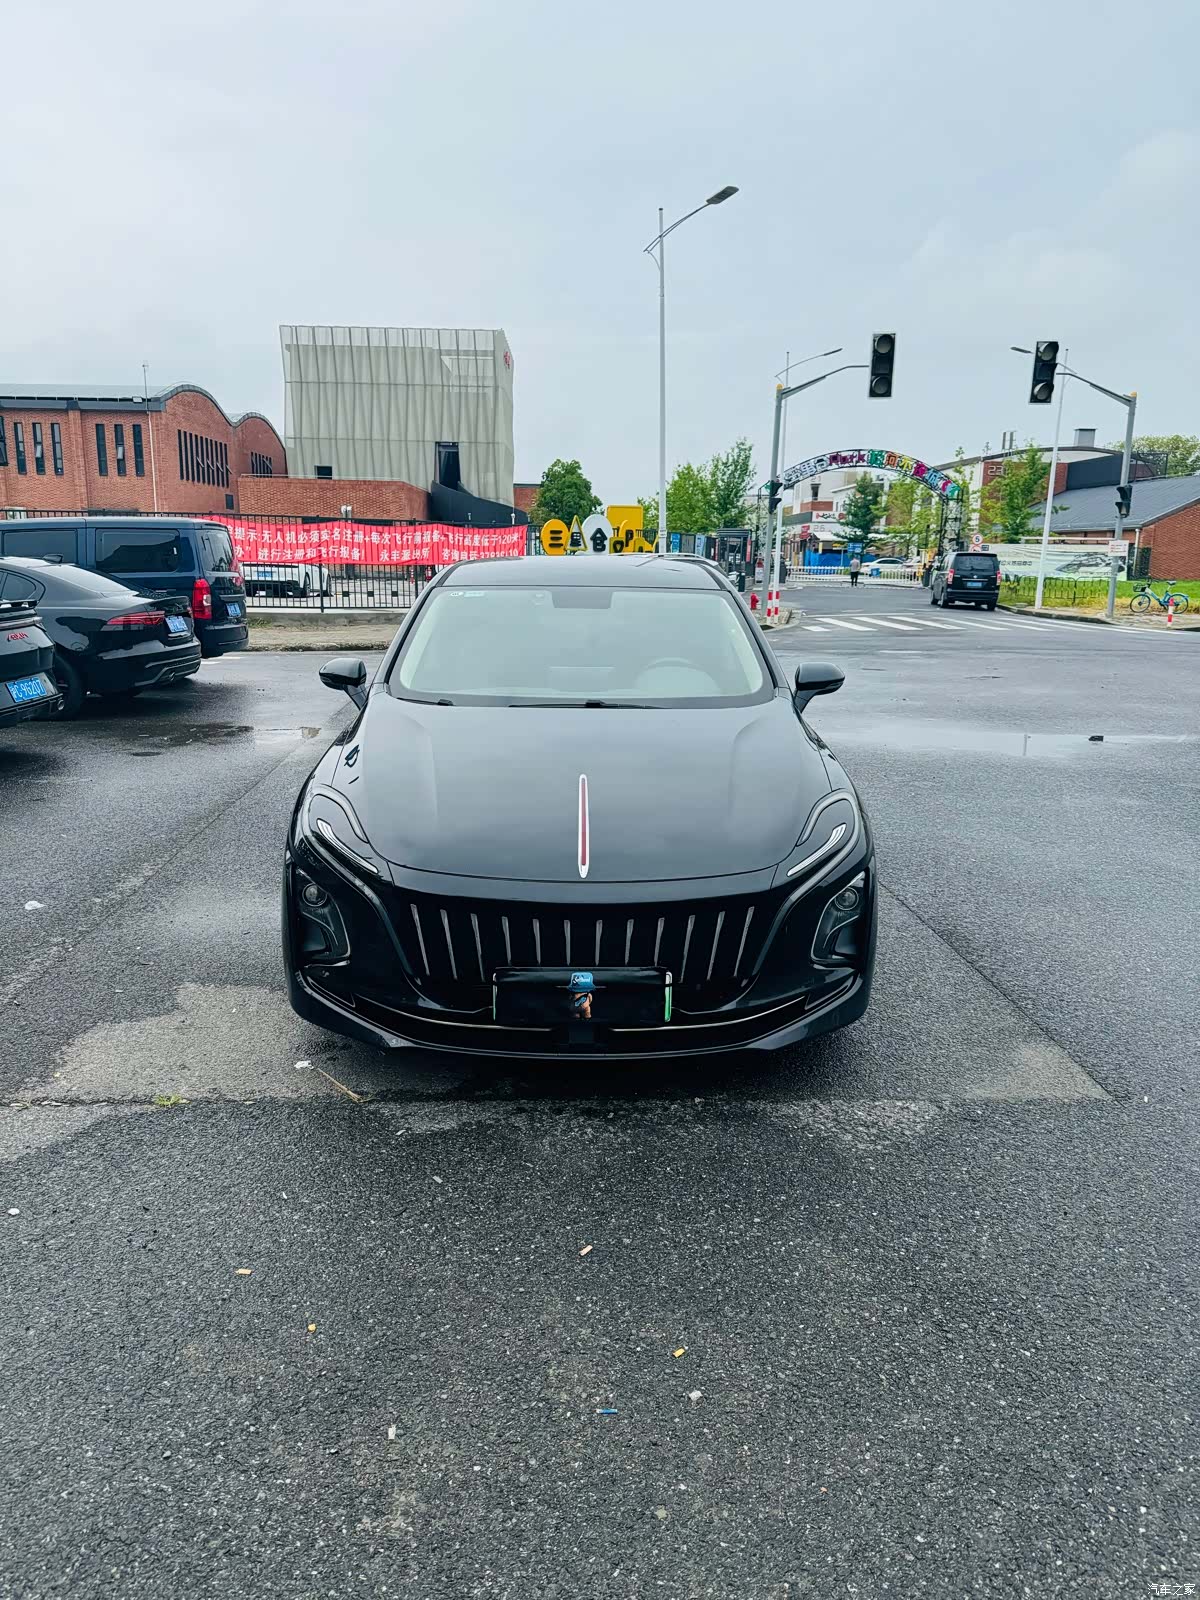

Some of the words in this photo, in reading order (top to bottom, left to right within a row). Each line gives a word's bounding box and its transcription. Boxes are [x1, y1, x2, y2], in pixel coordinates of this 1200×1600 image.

[380, 547, 430, 561] 永丰派出所
